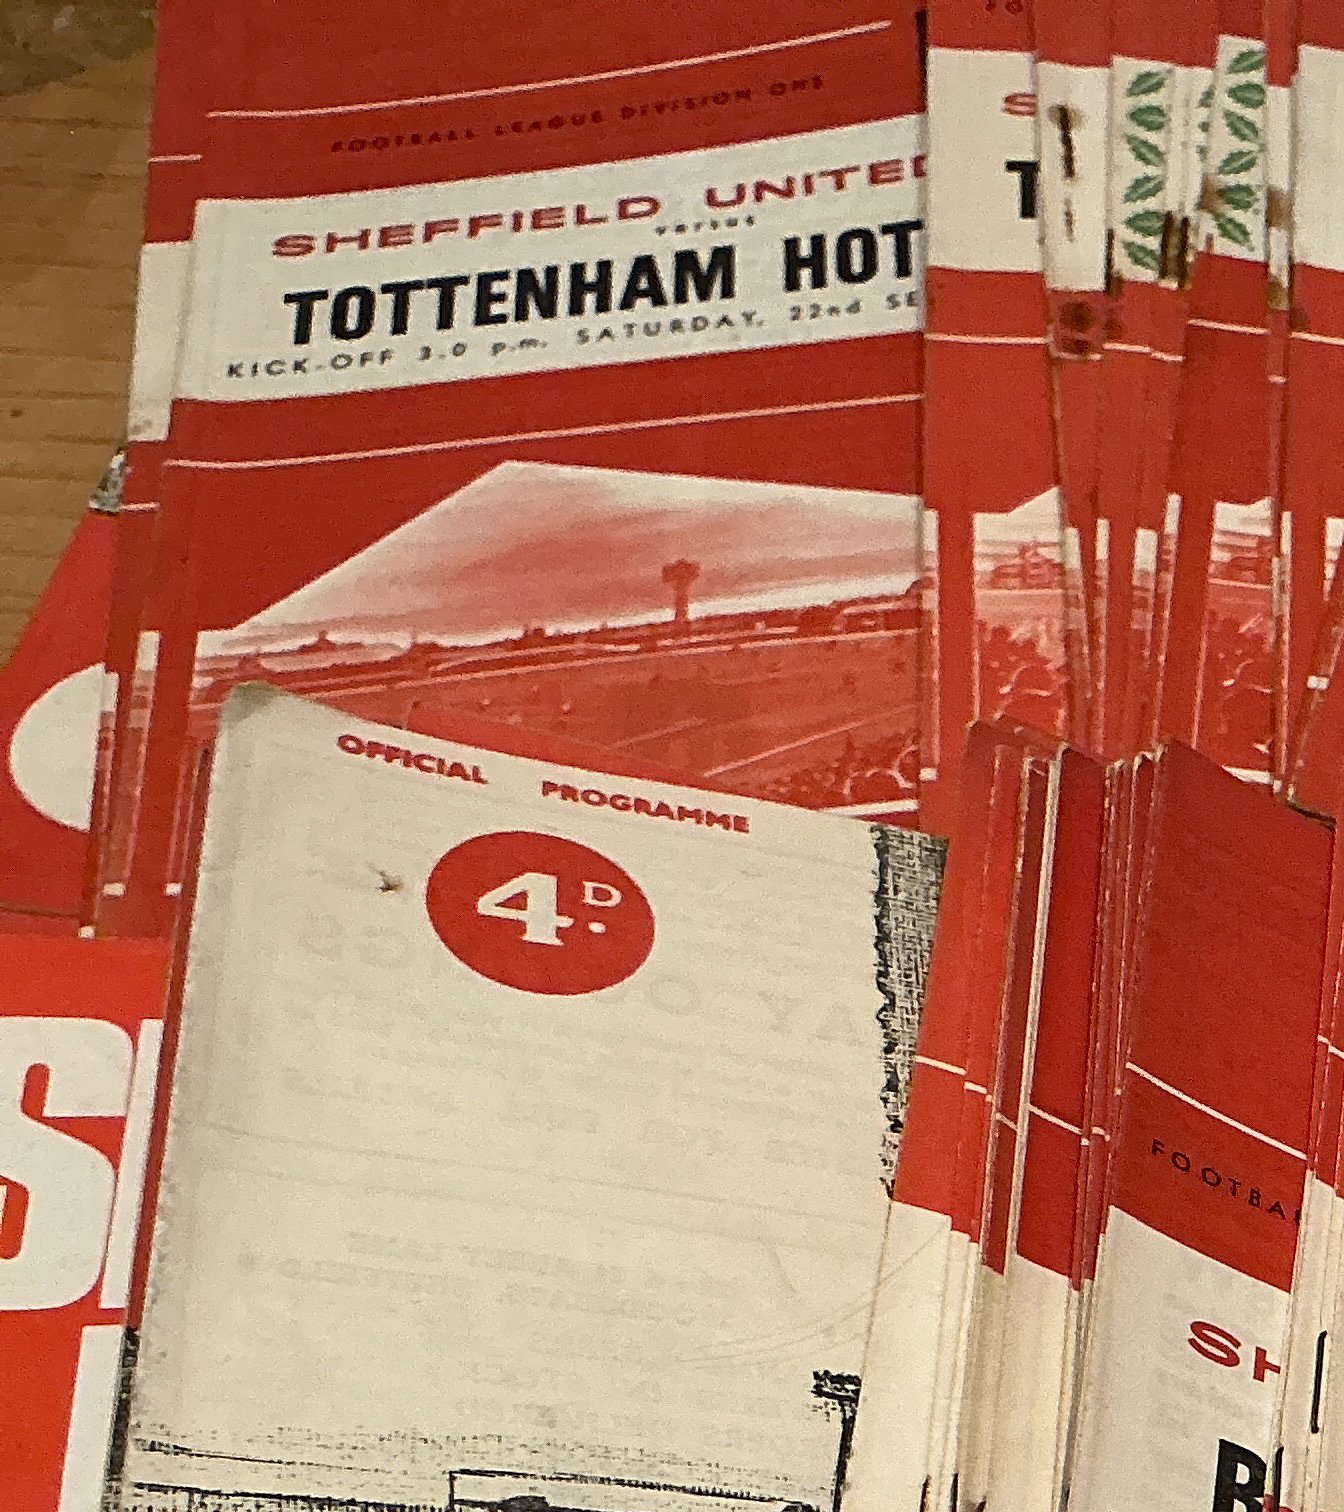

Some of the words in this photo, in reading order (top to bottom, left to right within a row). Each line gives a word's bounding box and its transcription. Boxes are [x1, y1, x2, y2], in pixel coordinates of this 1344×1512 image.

[272, 195, 661, 257] SHEFFIELD
[284, 245, 737, 344] TOTTENHAM
[227, 350, 393, 378] KICK-OFF
[336, 734, 488, 784] OFFICIAL
[541, 780, 750, 834] PROGRAMME
